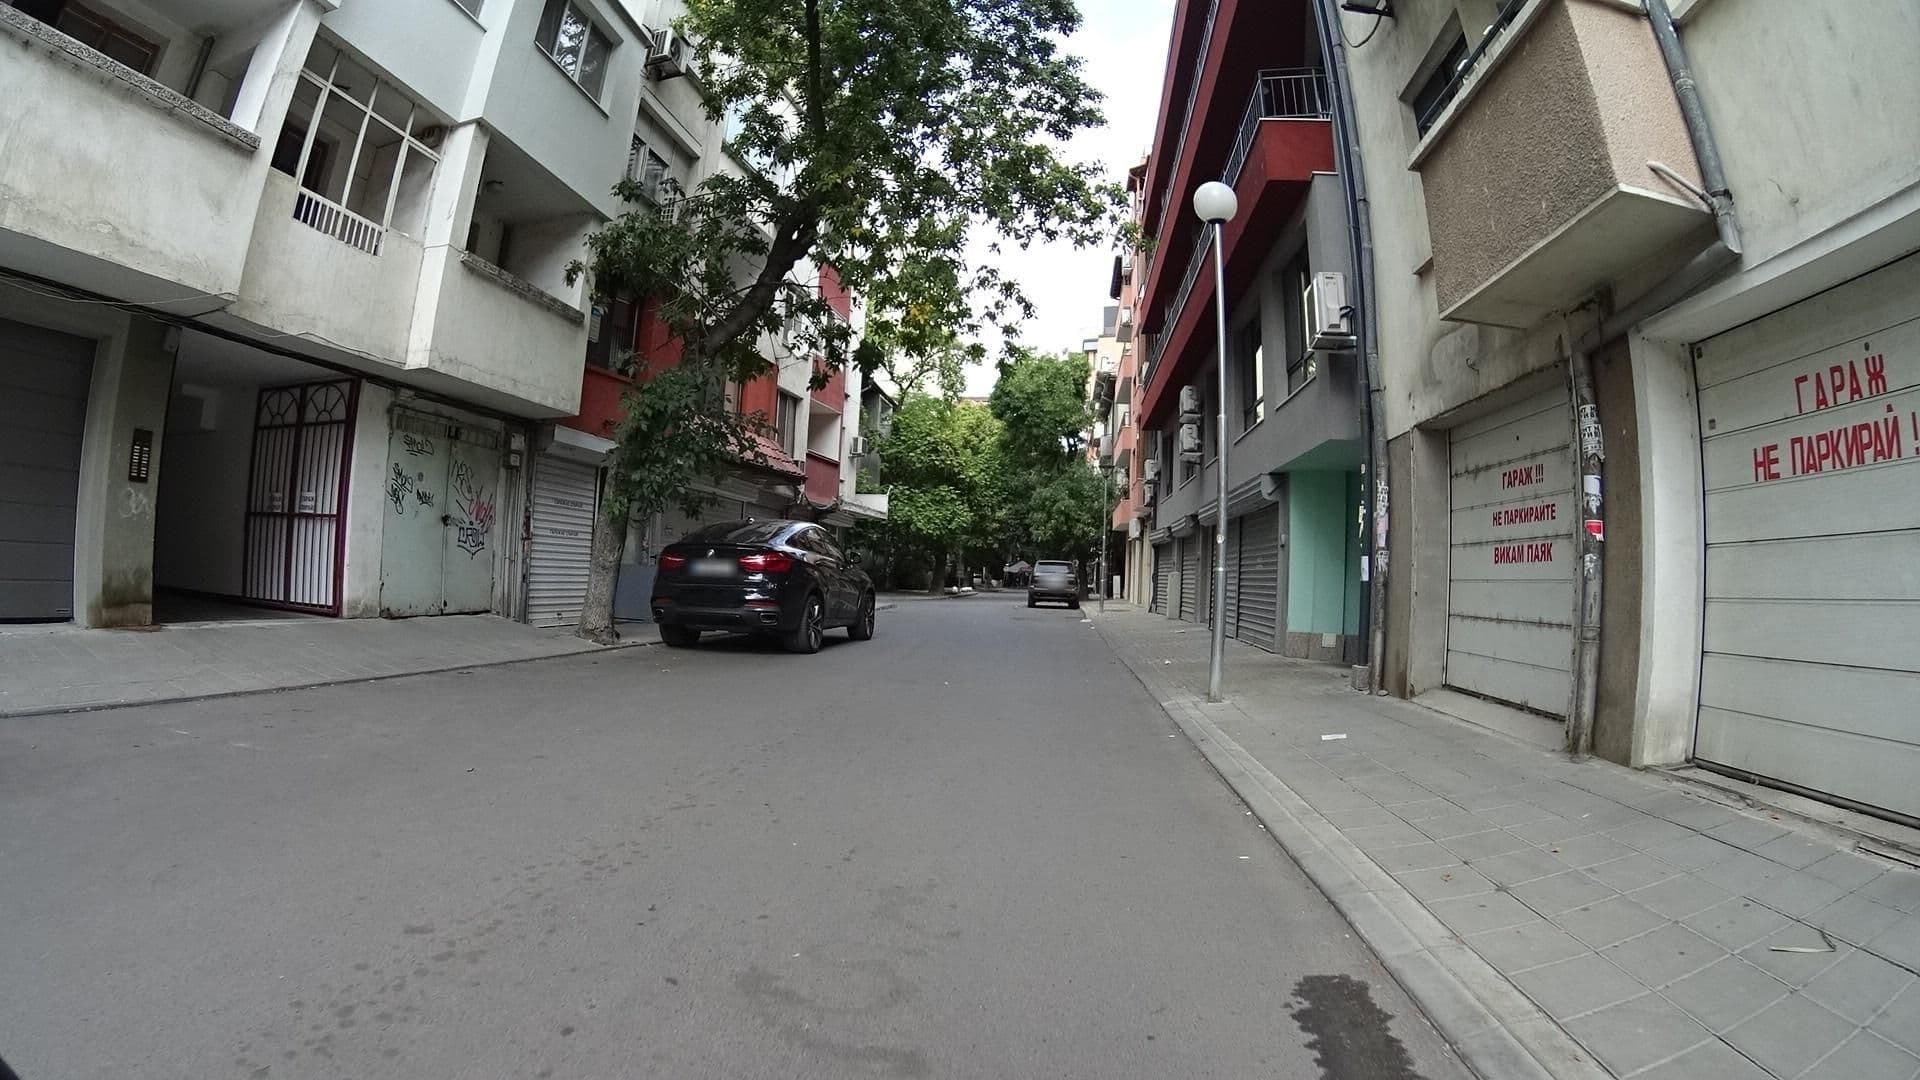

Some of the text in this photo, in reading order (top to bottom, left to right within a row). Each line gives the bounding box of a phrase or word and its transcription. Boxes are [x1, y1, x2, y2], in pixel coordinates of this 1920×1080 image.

[1794, 354, 1888, 415] ГАРАЖ
[1753, 443, 1781, 482] НЕ
[1790, 403, 1902, 476] ПАРКИРАЙ
[1502, 465, 1533, 490] ГАРАЖ
[1492, 511, 1502, 527] НЕ
[1494, 542, 1553, 565] ВИКАМ ПАЯК
